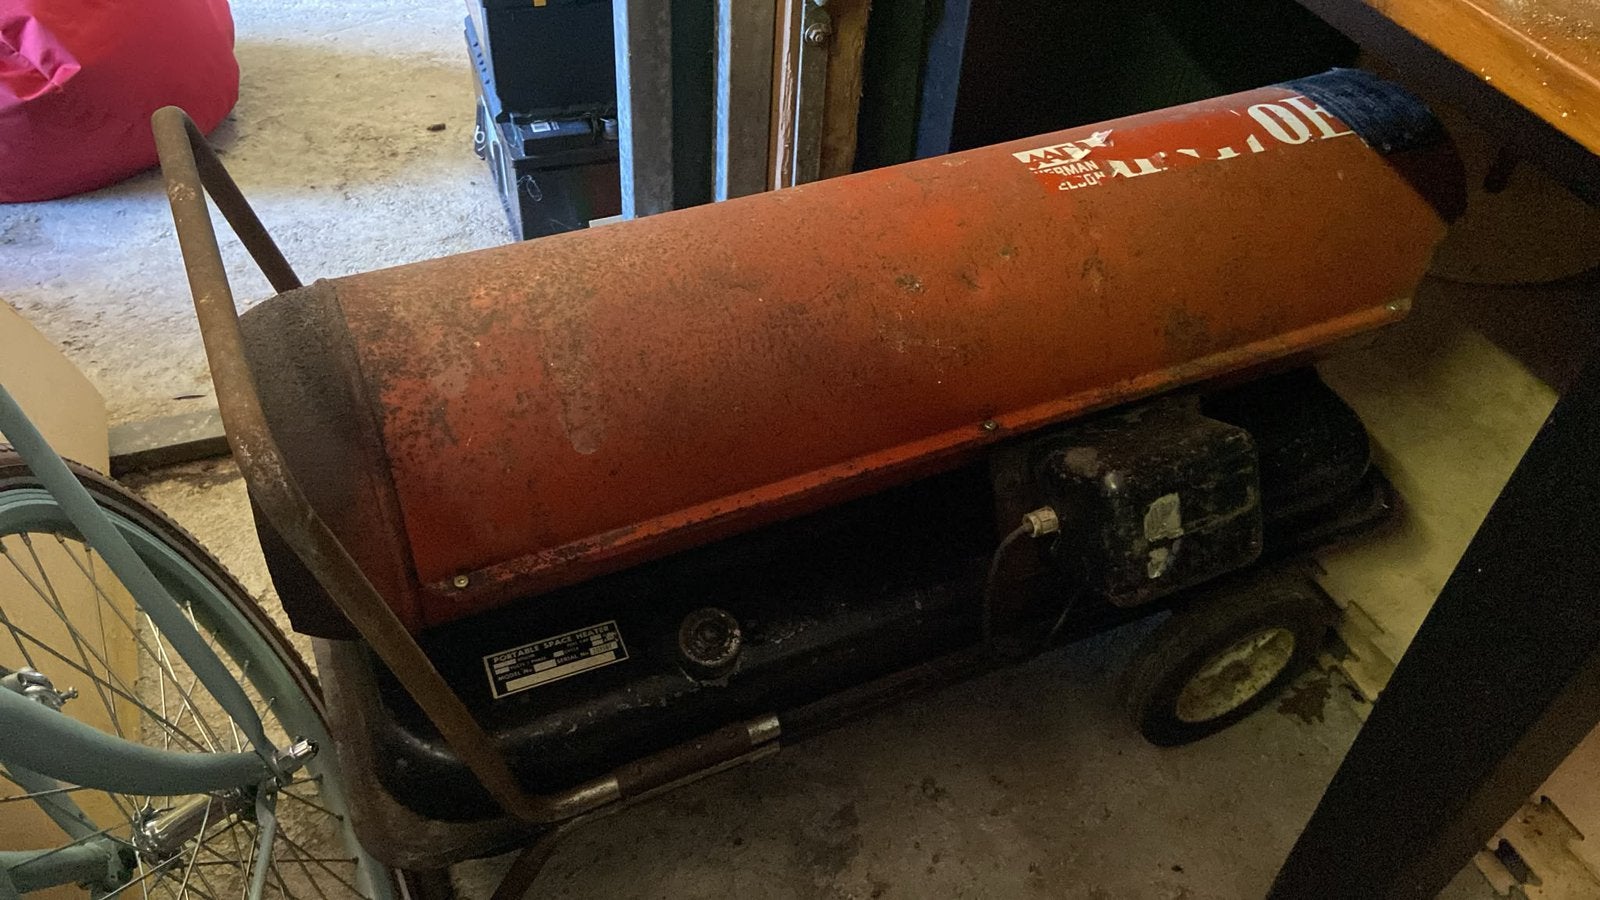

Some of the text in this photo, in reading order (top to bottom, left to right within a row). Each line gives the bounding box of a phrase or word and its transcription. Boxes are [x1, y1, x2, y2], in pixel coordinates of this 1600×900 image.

[493, 646, 539, 663] PORTABLE
[543, 638, 573, 649] SPACE
[576, 626, 609, 639] HEATER
